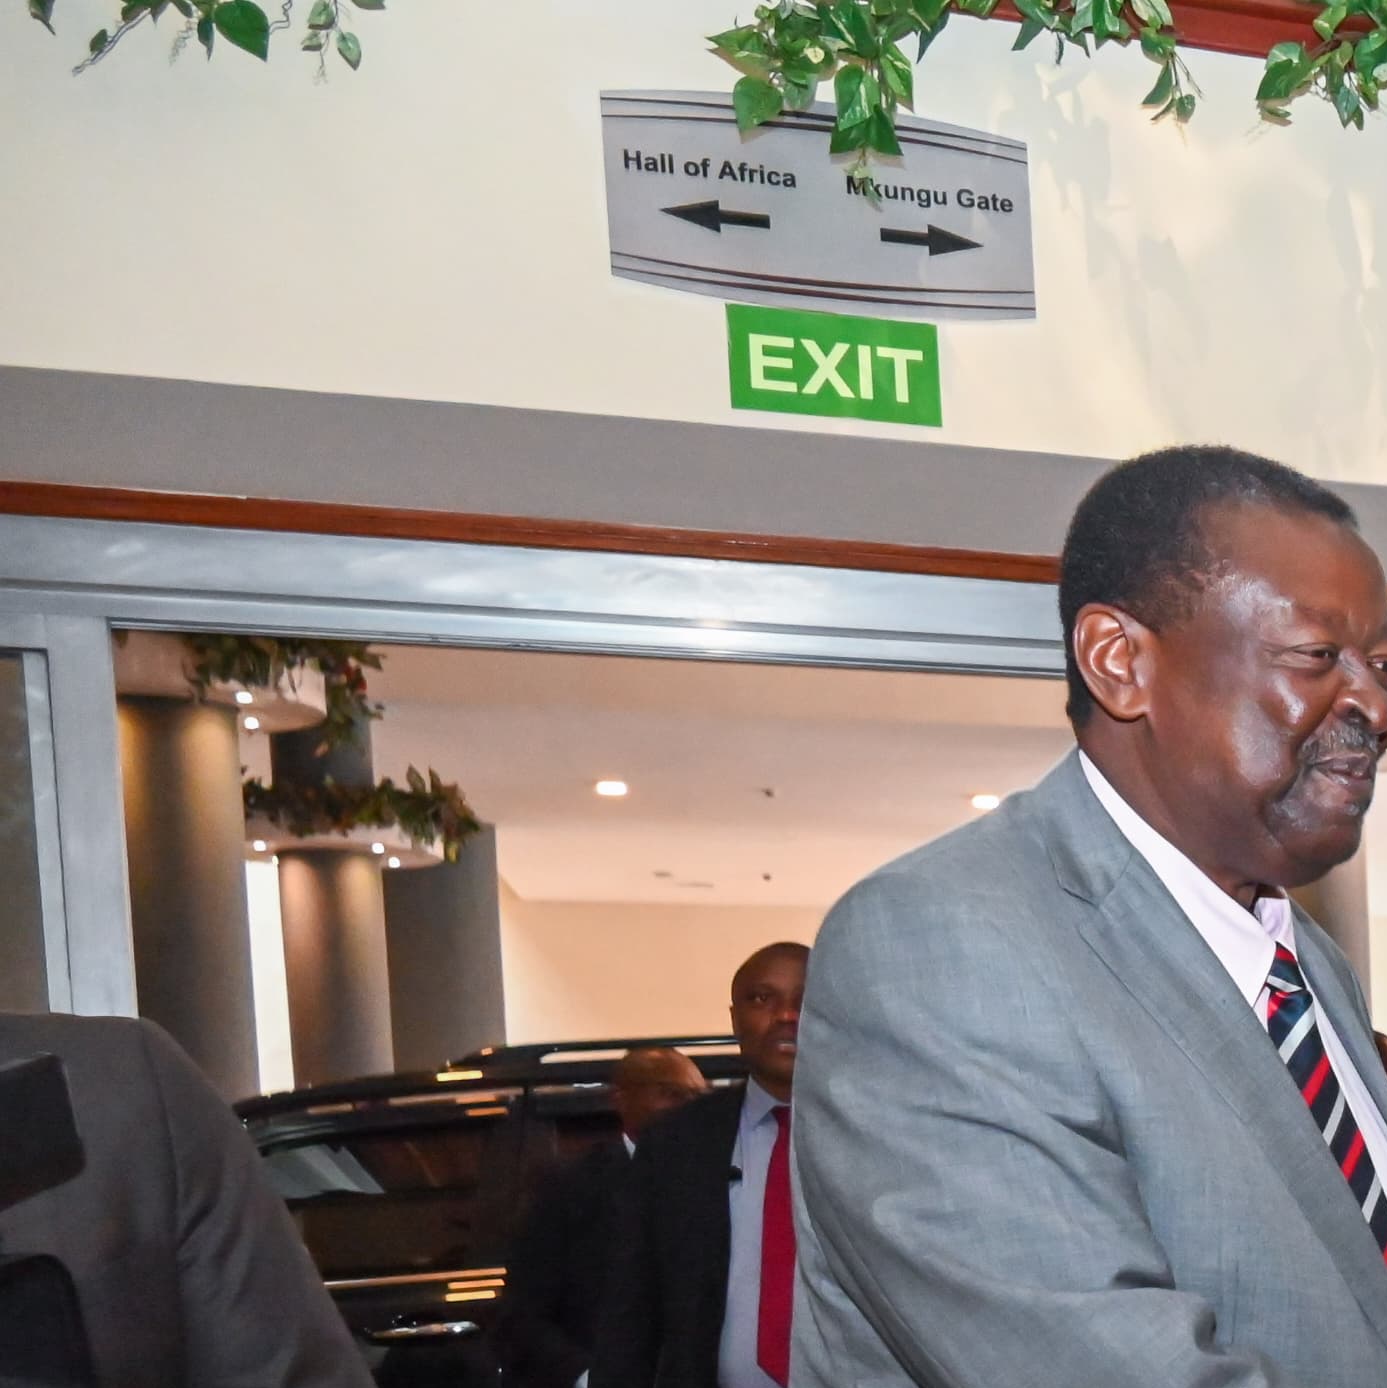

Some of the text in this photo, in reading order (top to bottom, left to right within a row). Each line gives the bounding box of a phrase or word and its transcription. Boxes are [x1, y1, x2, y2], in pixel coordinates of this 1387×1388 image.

[623, 148, 797, 188] Hall of Africa
[956, 188, 1013, 213] Gate
[748, 333, 923, 403] EXIT
